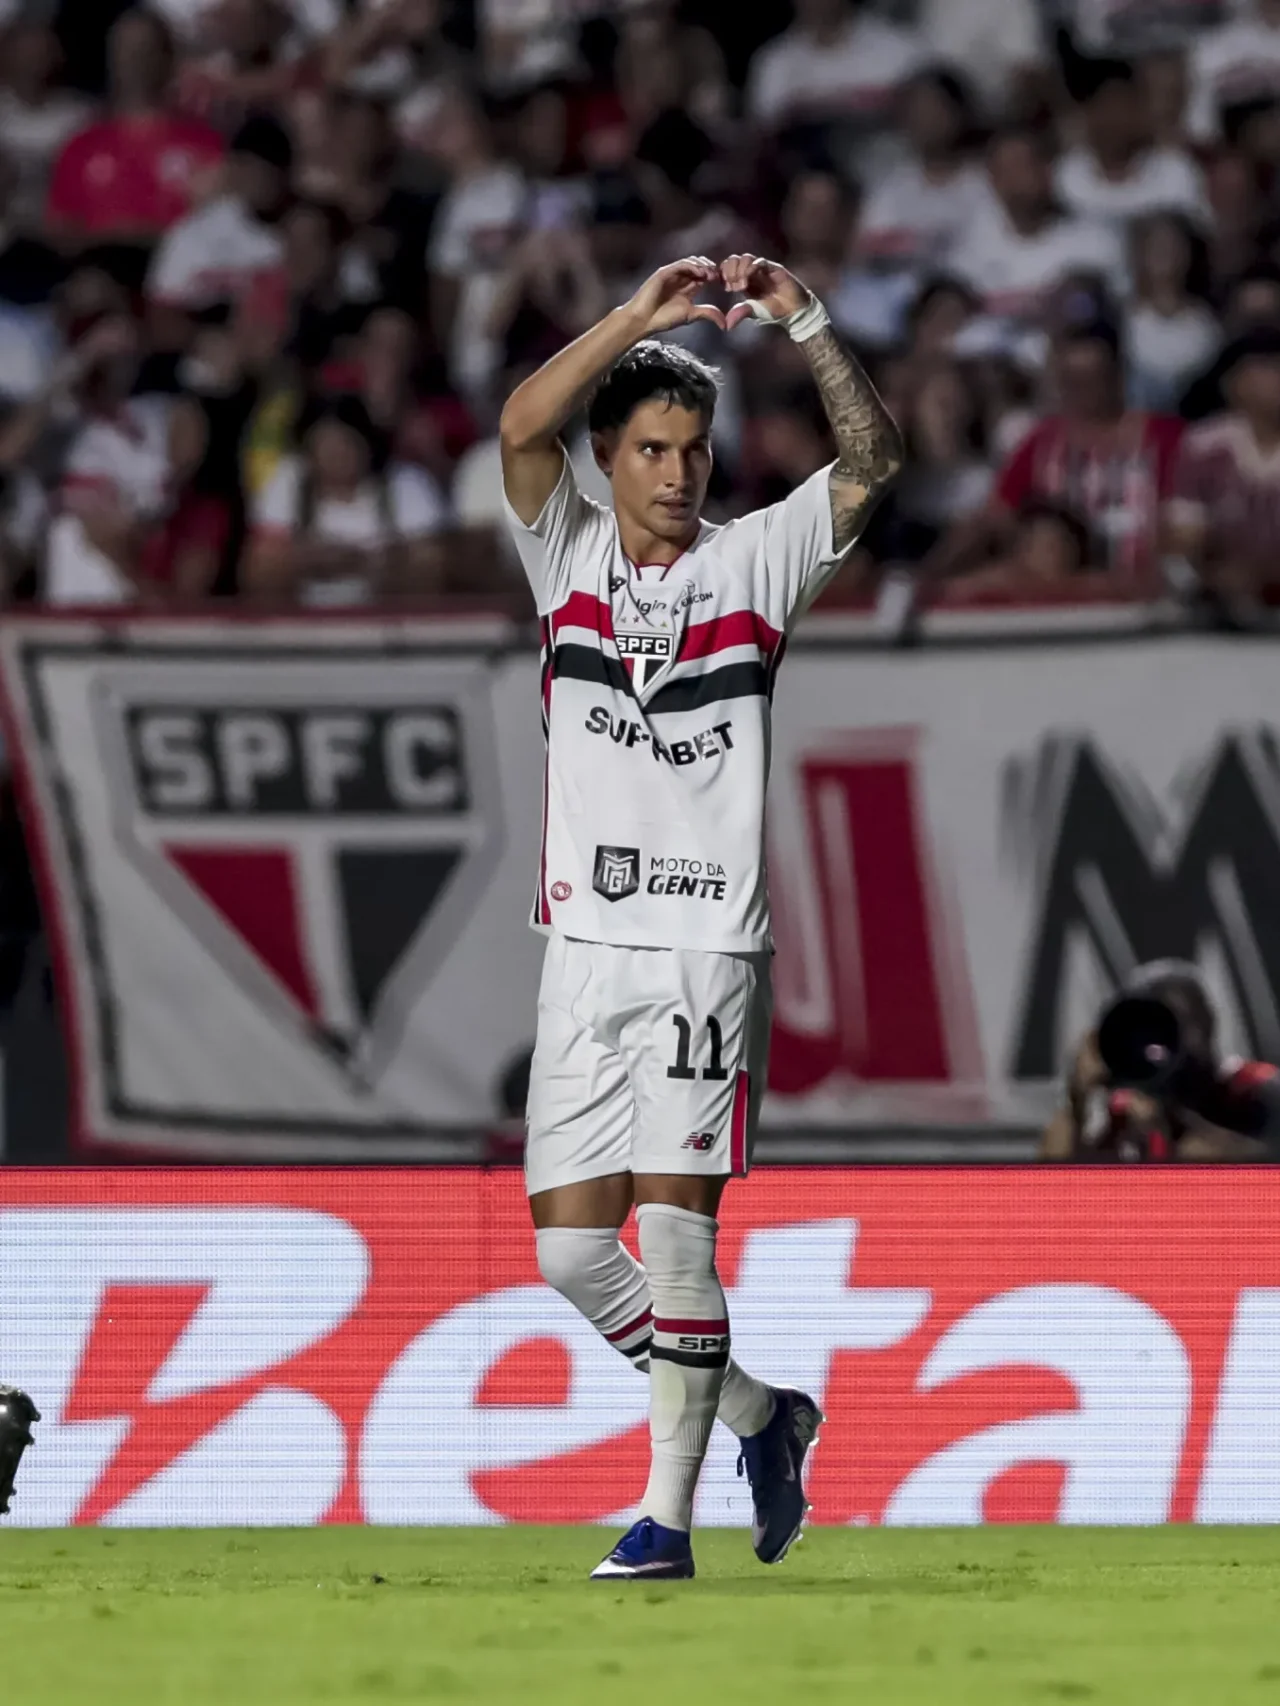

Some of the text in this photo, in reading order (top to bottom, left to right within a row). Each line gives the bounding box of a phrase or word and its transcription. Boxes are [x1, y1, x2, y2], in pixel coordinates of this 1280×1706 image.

[616, 637, 667, 654] SPFC
[138, 714, 459, 804] SPFC
[651, 857, 726, 877] MOTO DA
[647, 875, 726, 900] GENTE
[667, 1014, 728, 1080] 11
